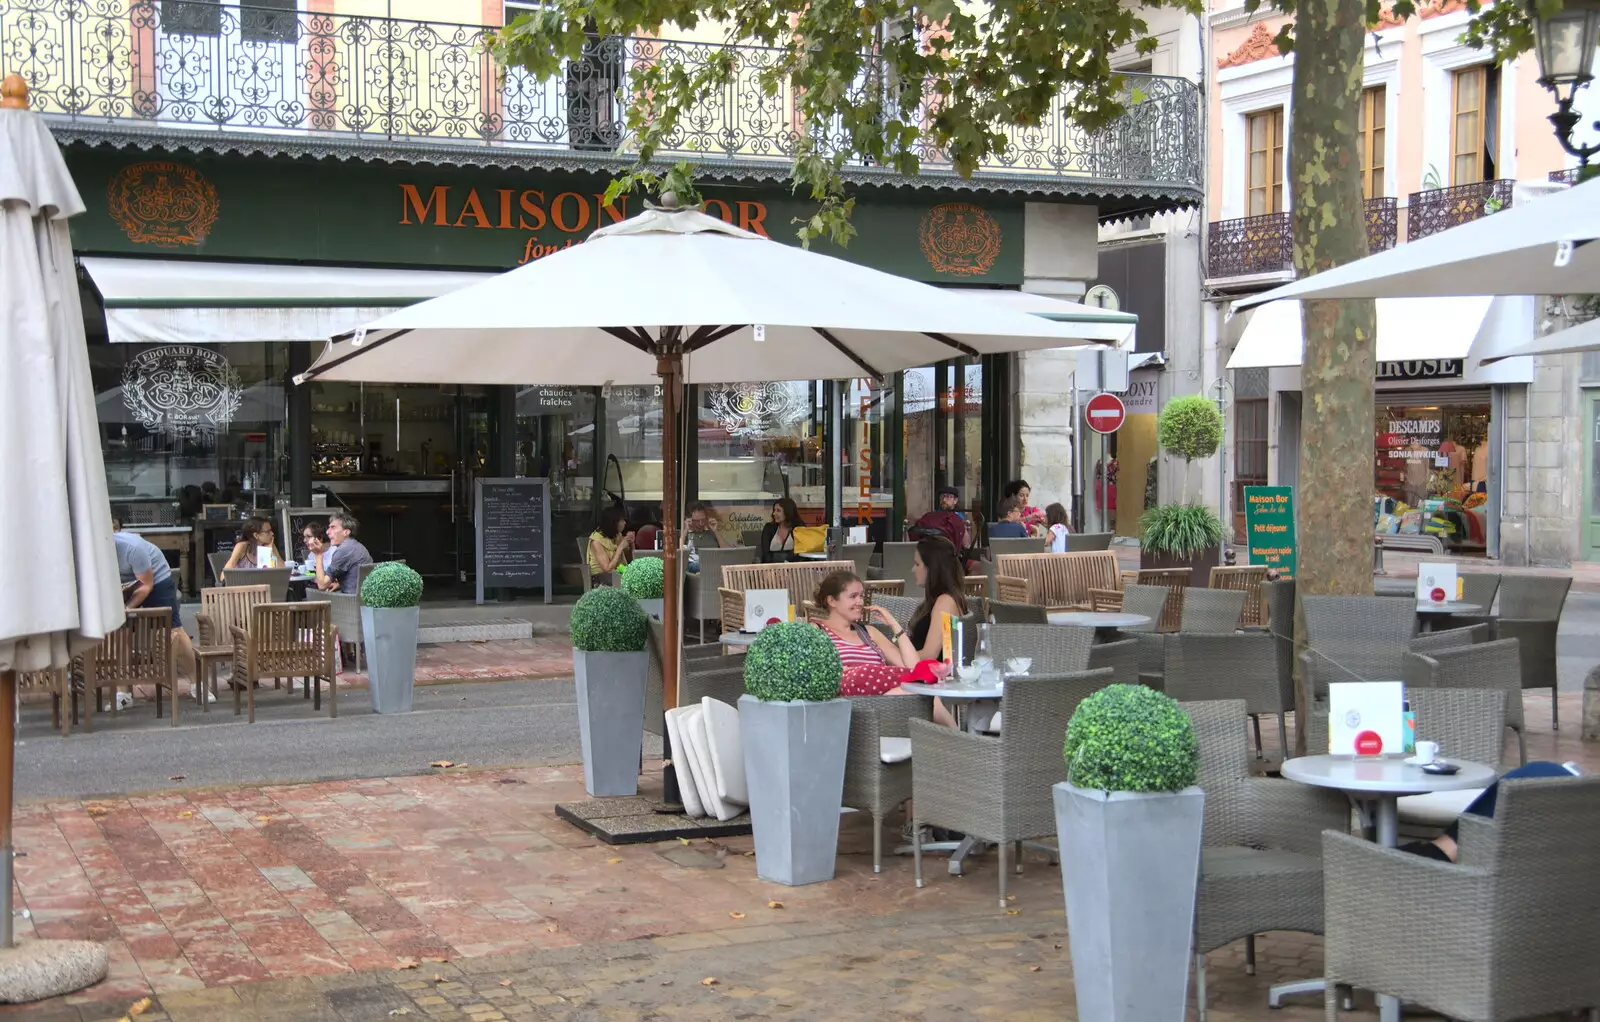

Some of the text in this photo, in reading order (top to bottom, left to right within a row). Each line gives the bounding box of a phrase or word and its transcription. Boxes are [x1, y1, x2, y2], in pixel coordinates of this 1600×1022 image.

[399, 183, 773, 241] MAISON OR
[518, 237, 584, 265] fond
[142, 347, 218, 362] EDOUARD BOR
[1375, 359, 1455, 377] ROSE
[539, 388, 573, 397] chaudes
[540, 397, 572, 406] fraîches
[1388, 419, 1441, 434] DESCAMPS
[1388, 435, 1440, 447] Olivier Desforges
[1388, 450, 1440, 459] SONIA RYKIEL
[1249, 494, 1289, 503] Maison Bor
[729, 511, 763, 522] Création
[716, 522, 765, 532] GOURMAN
